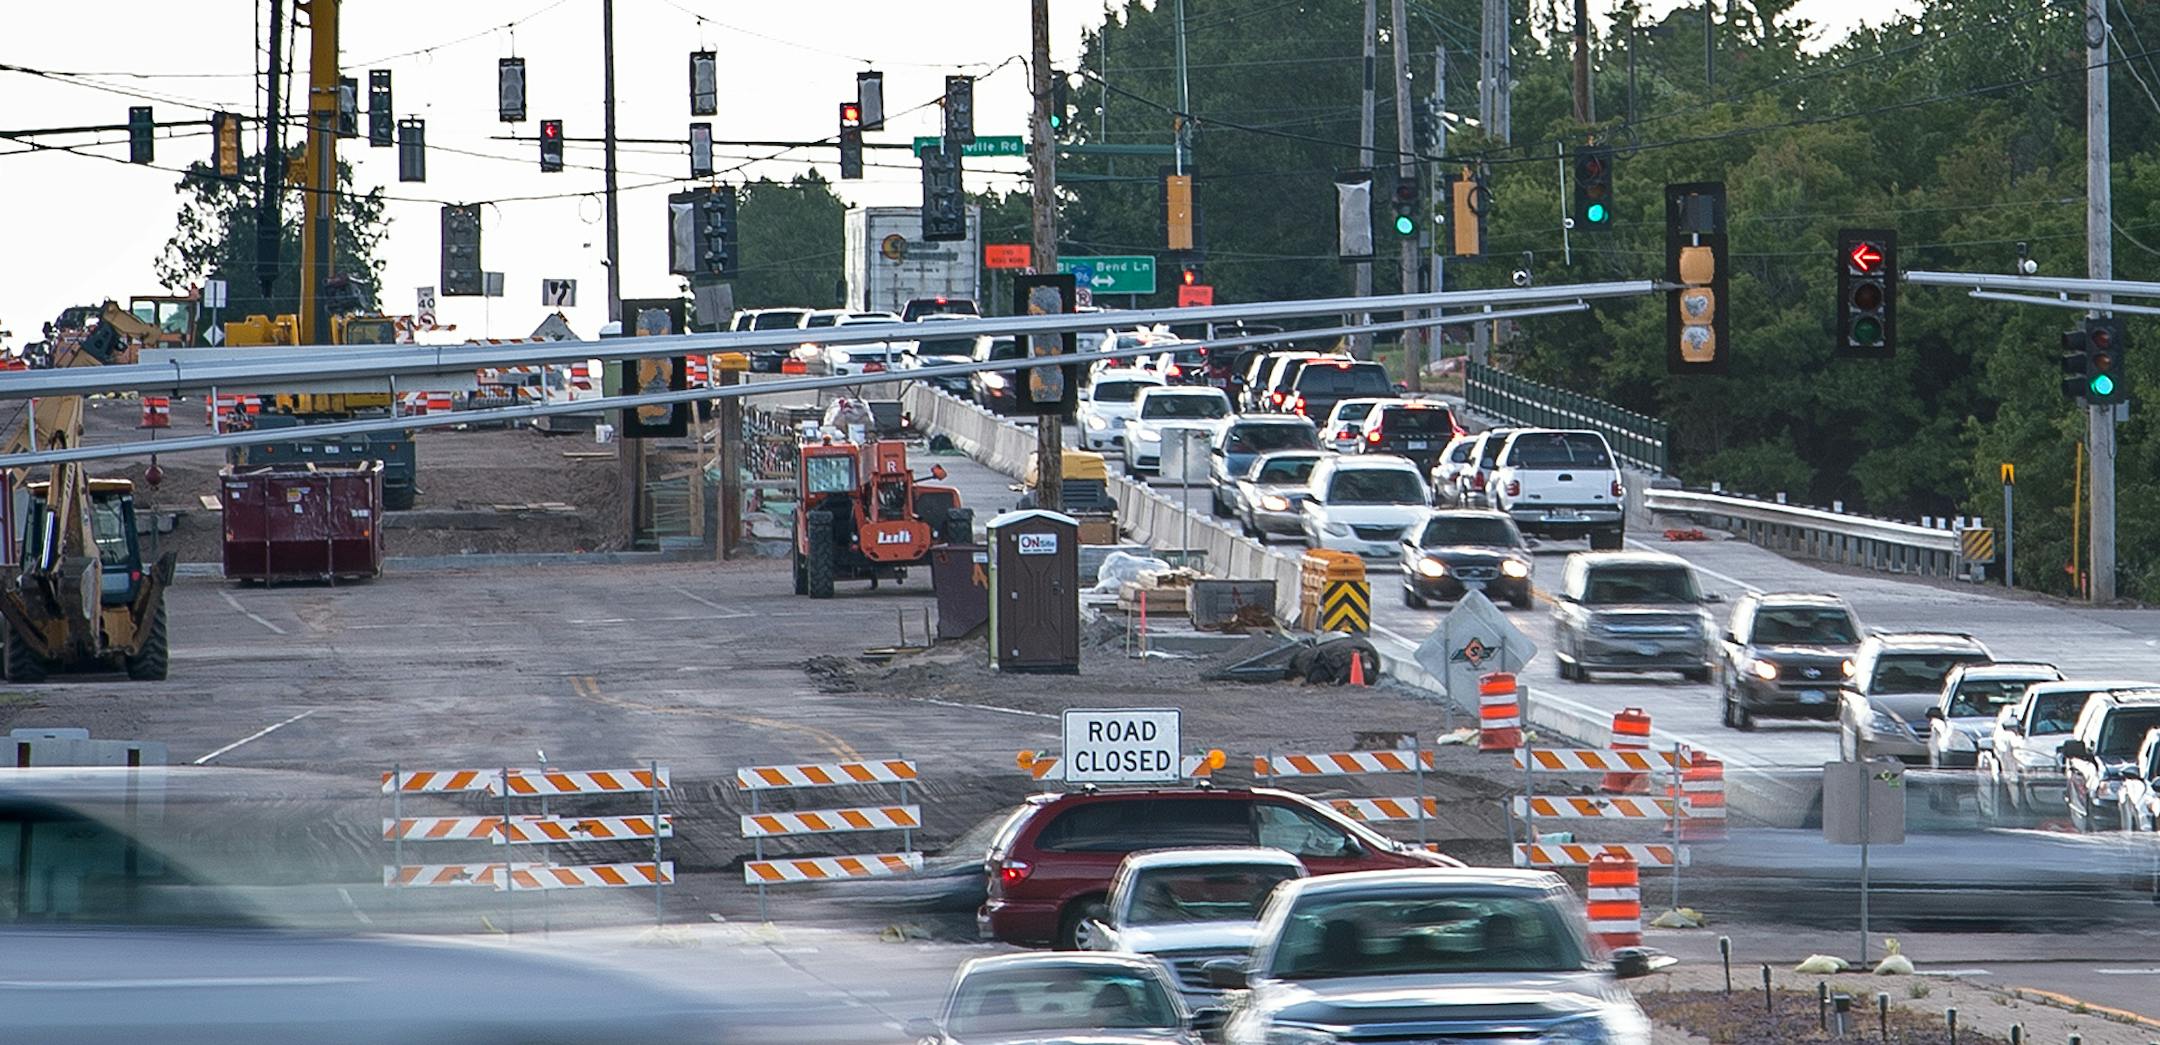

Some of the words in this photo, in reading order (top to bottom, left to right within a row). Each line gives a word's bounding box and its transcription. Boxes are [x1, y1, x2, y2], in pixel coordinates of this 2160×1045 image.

[1001, 141, 1018, 151] Rd
[1096, 262, 1128, 272] Bend
[1134, 262, 1150, 272] Ln
[418, 298, 435, 309] 40
[877, 530, 911, 545] Lull
[1089, 720, 1157, 742] ROAD
[1075, 750, 1171, 773] CLOSED
